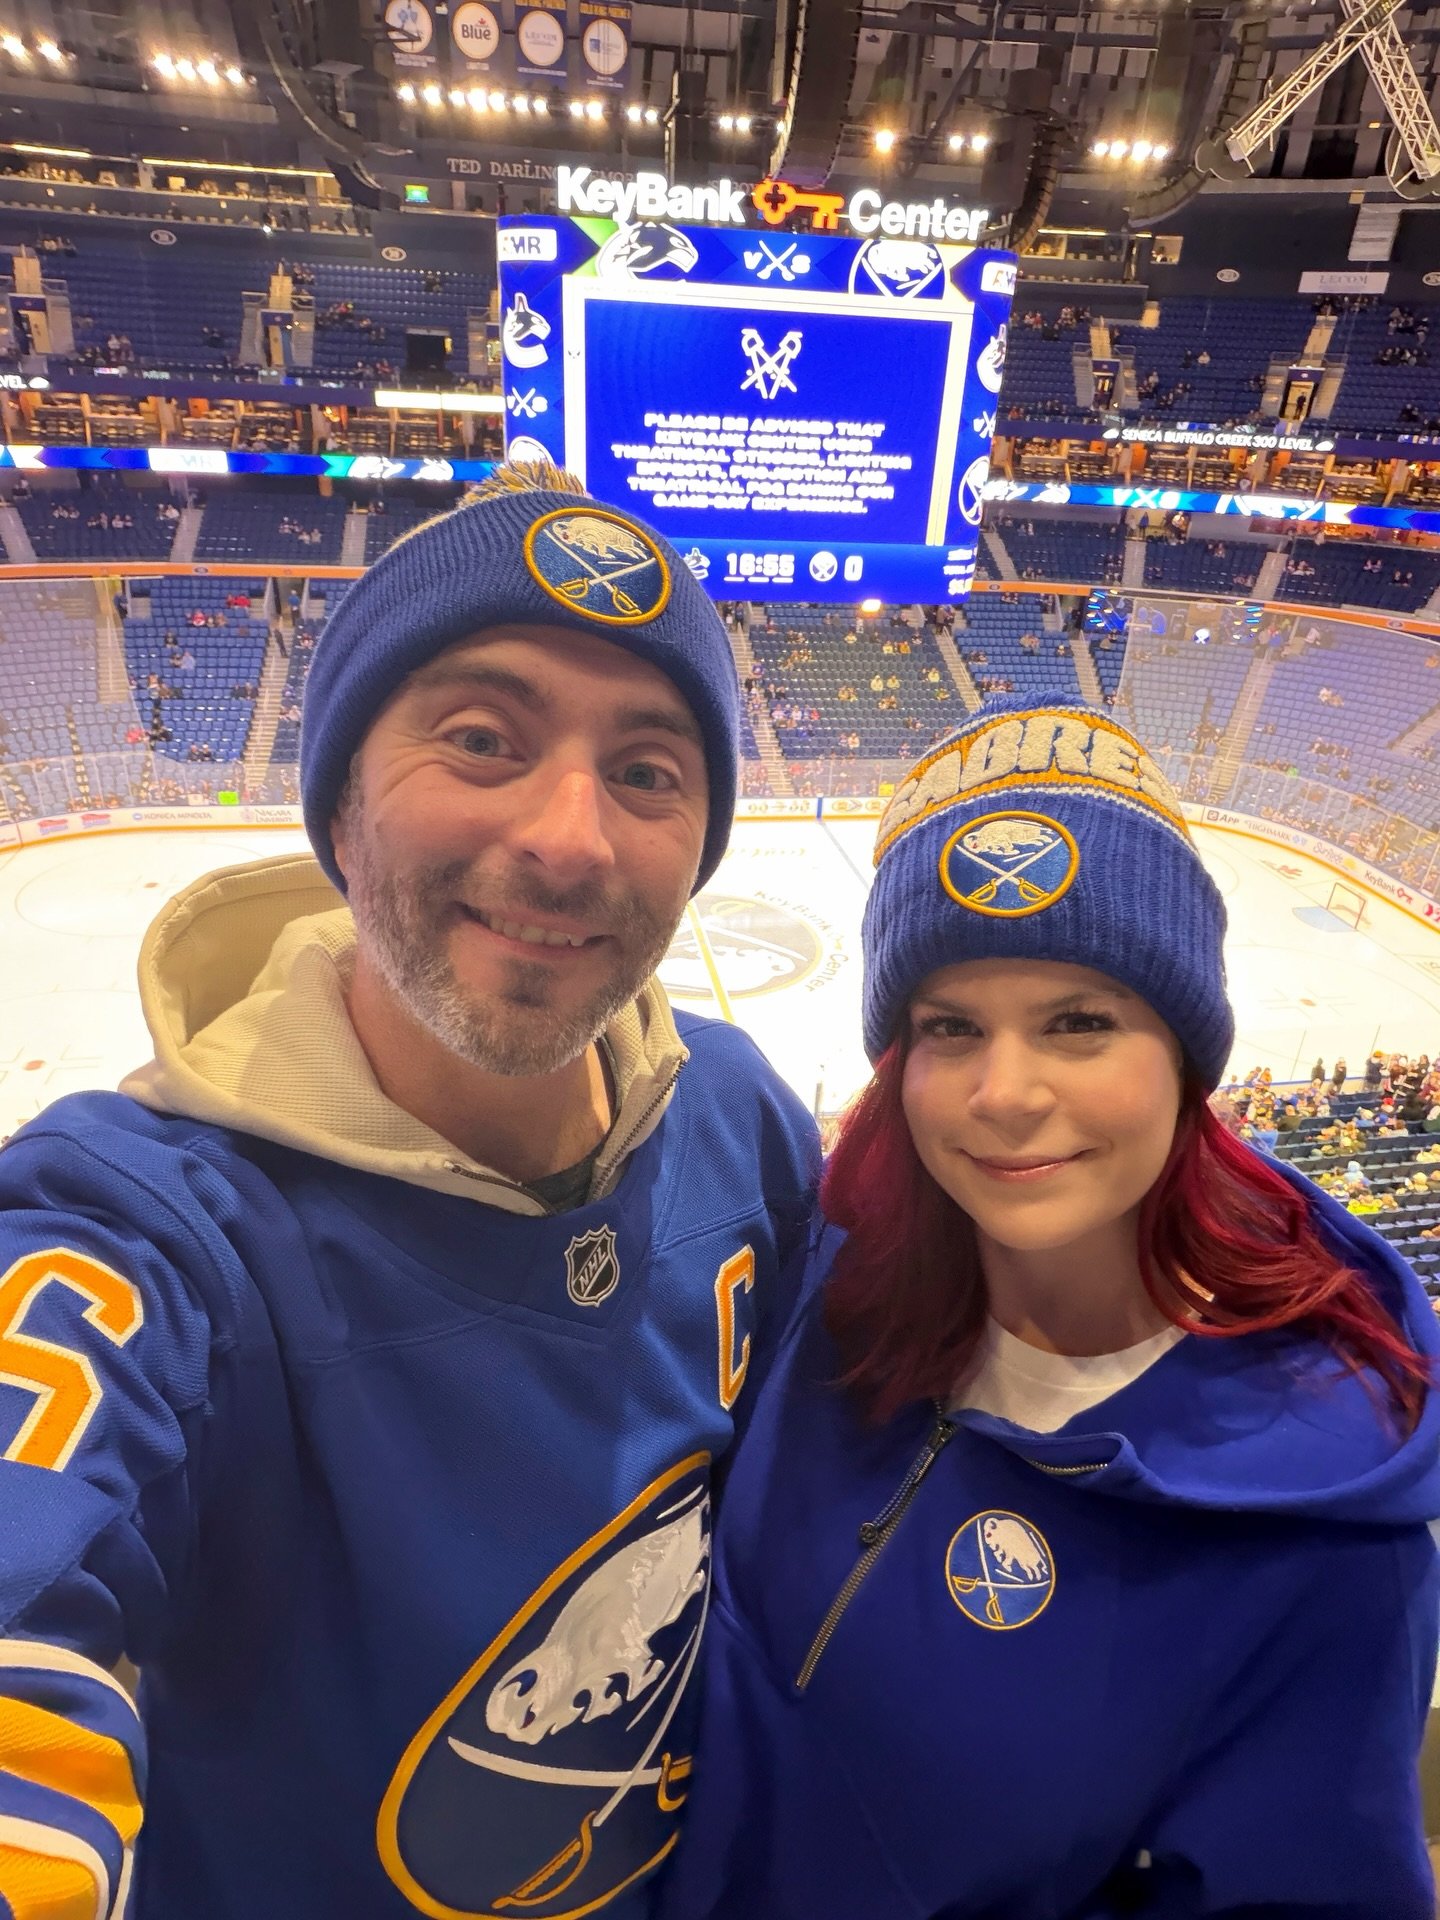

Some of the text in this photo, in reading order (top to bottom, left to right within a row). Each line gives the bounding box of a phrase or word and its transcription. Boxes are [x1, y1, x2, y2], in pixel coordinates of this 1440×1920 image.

[461, 23, 492, 40] Blue
[446, 158, 481, 174] TED
[489, 161, 562, 181] DARLIN
[557, 165, 990, 241] KeyBank Center
[0, 374, 27, 388] VEL
[834, 422, 886, 437] THAT
[1121, 428, 1315, 452] SENECA BUFFALO CREEK 300 LEVEL
[844, 555, 864, 581] 0
[1364, 870, 1396, 895] KeyBank
[579, 1245, 608, 1293] NHL
[715, 1243, 755, 1412] C
